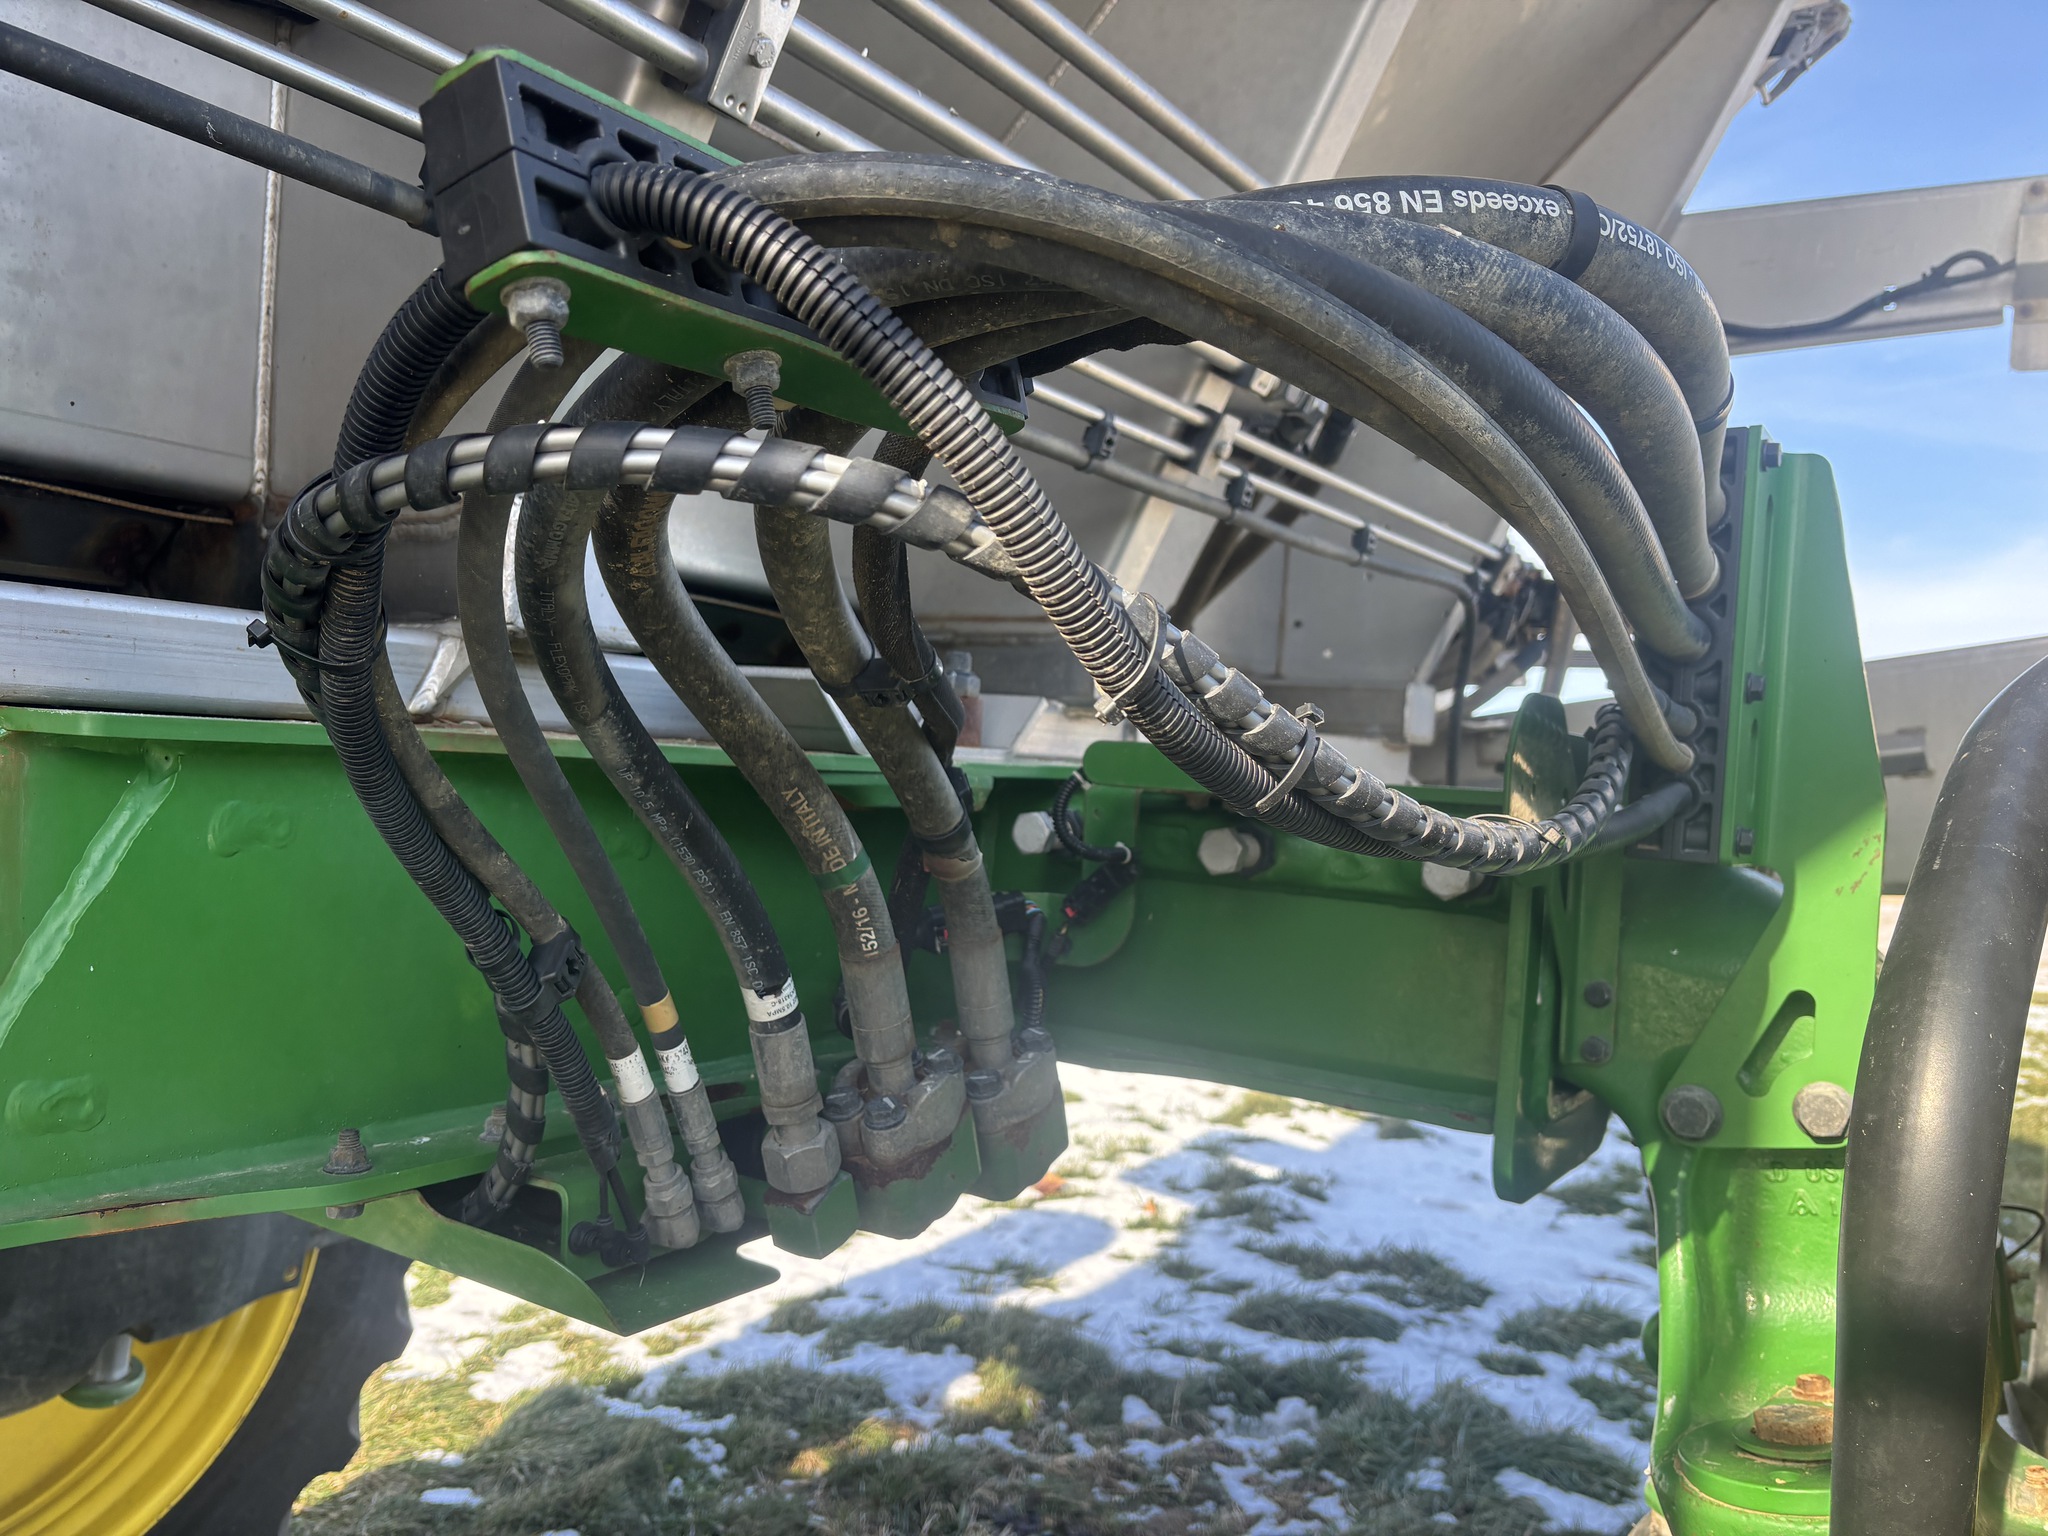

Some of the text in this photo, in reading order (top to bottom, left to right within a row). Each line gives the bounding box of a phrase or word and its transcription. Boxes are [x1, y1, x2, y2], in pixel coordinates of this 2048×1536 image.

[1399, 189, 1444, 214] EN
[1450, 188, 1561, 218] exceeds
[1665, 246, 1688, 280] ISO
[539, 590, 558, 625] ITALY
[780, 785, 822, 828] ITALY
[811, 826, 833, 848] IN
[630, 785, 655, 811] 10.5
[650, 811, 669, 833] MPa
[668, 836, 697, 867] (1530
[692, 868, 716, 895] PSI)
[719, 910, 737, 927] EN
[729, 928, 749, 951] 857
[742, 955, 760, 976] 1SC
